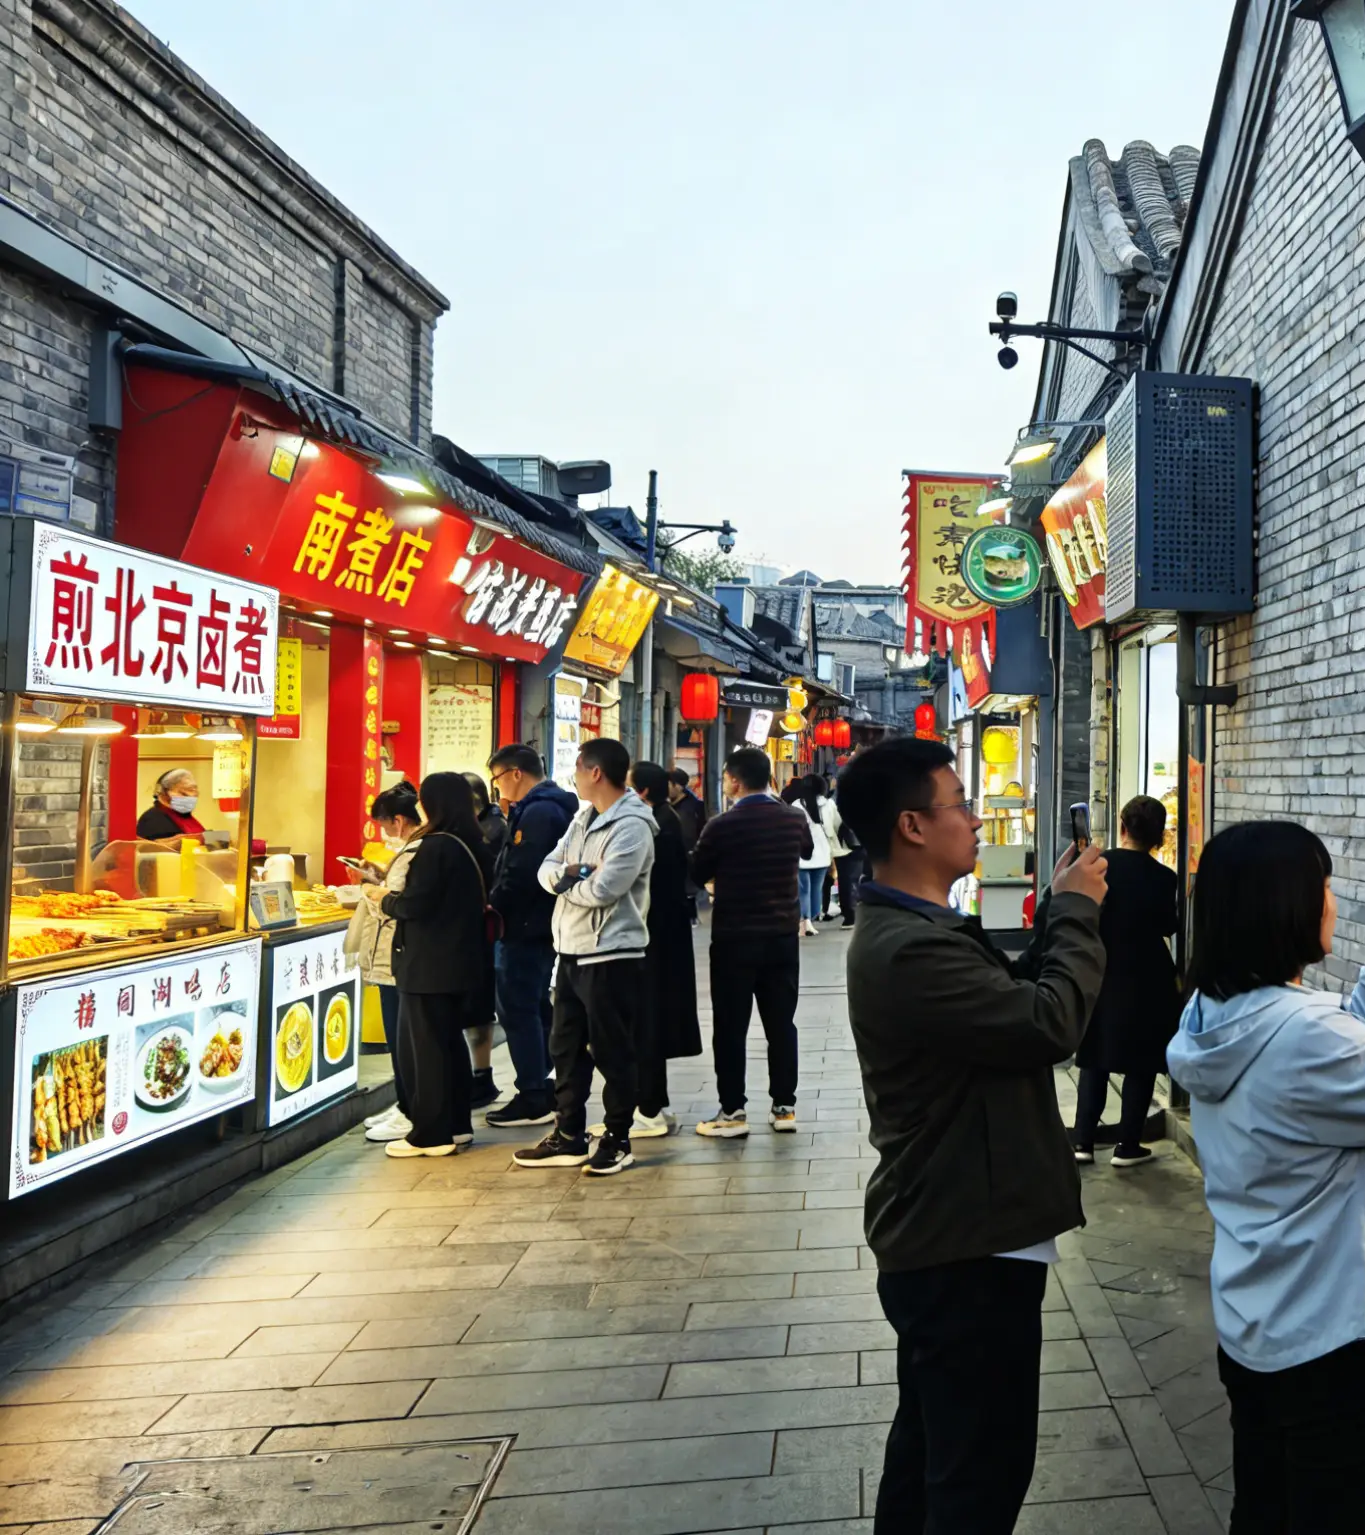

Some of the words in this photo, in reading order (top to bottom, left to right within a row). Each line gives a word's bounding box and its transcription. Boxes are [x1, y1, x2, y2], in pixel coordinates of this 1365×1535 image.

[293, 491, 432, 607] 南煮店
[44, 551, 268, 695] 煎北京卤煮
